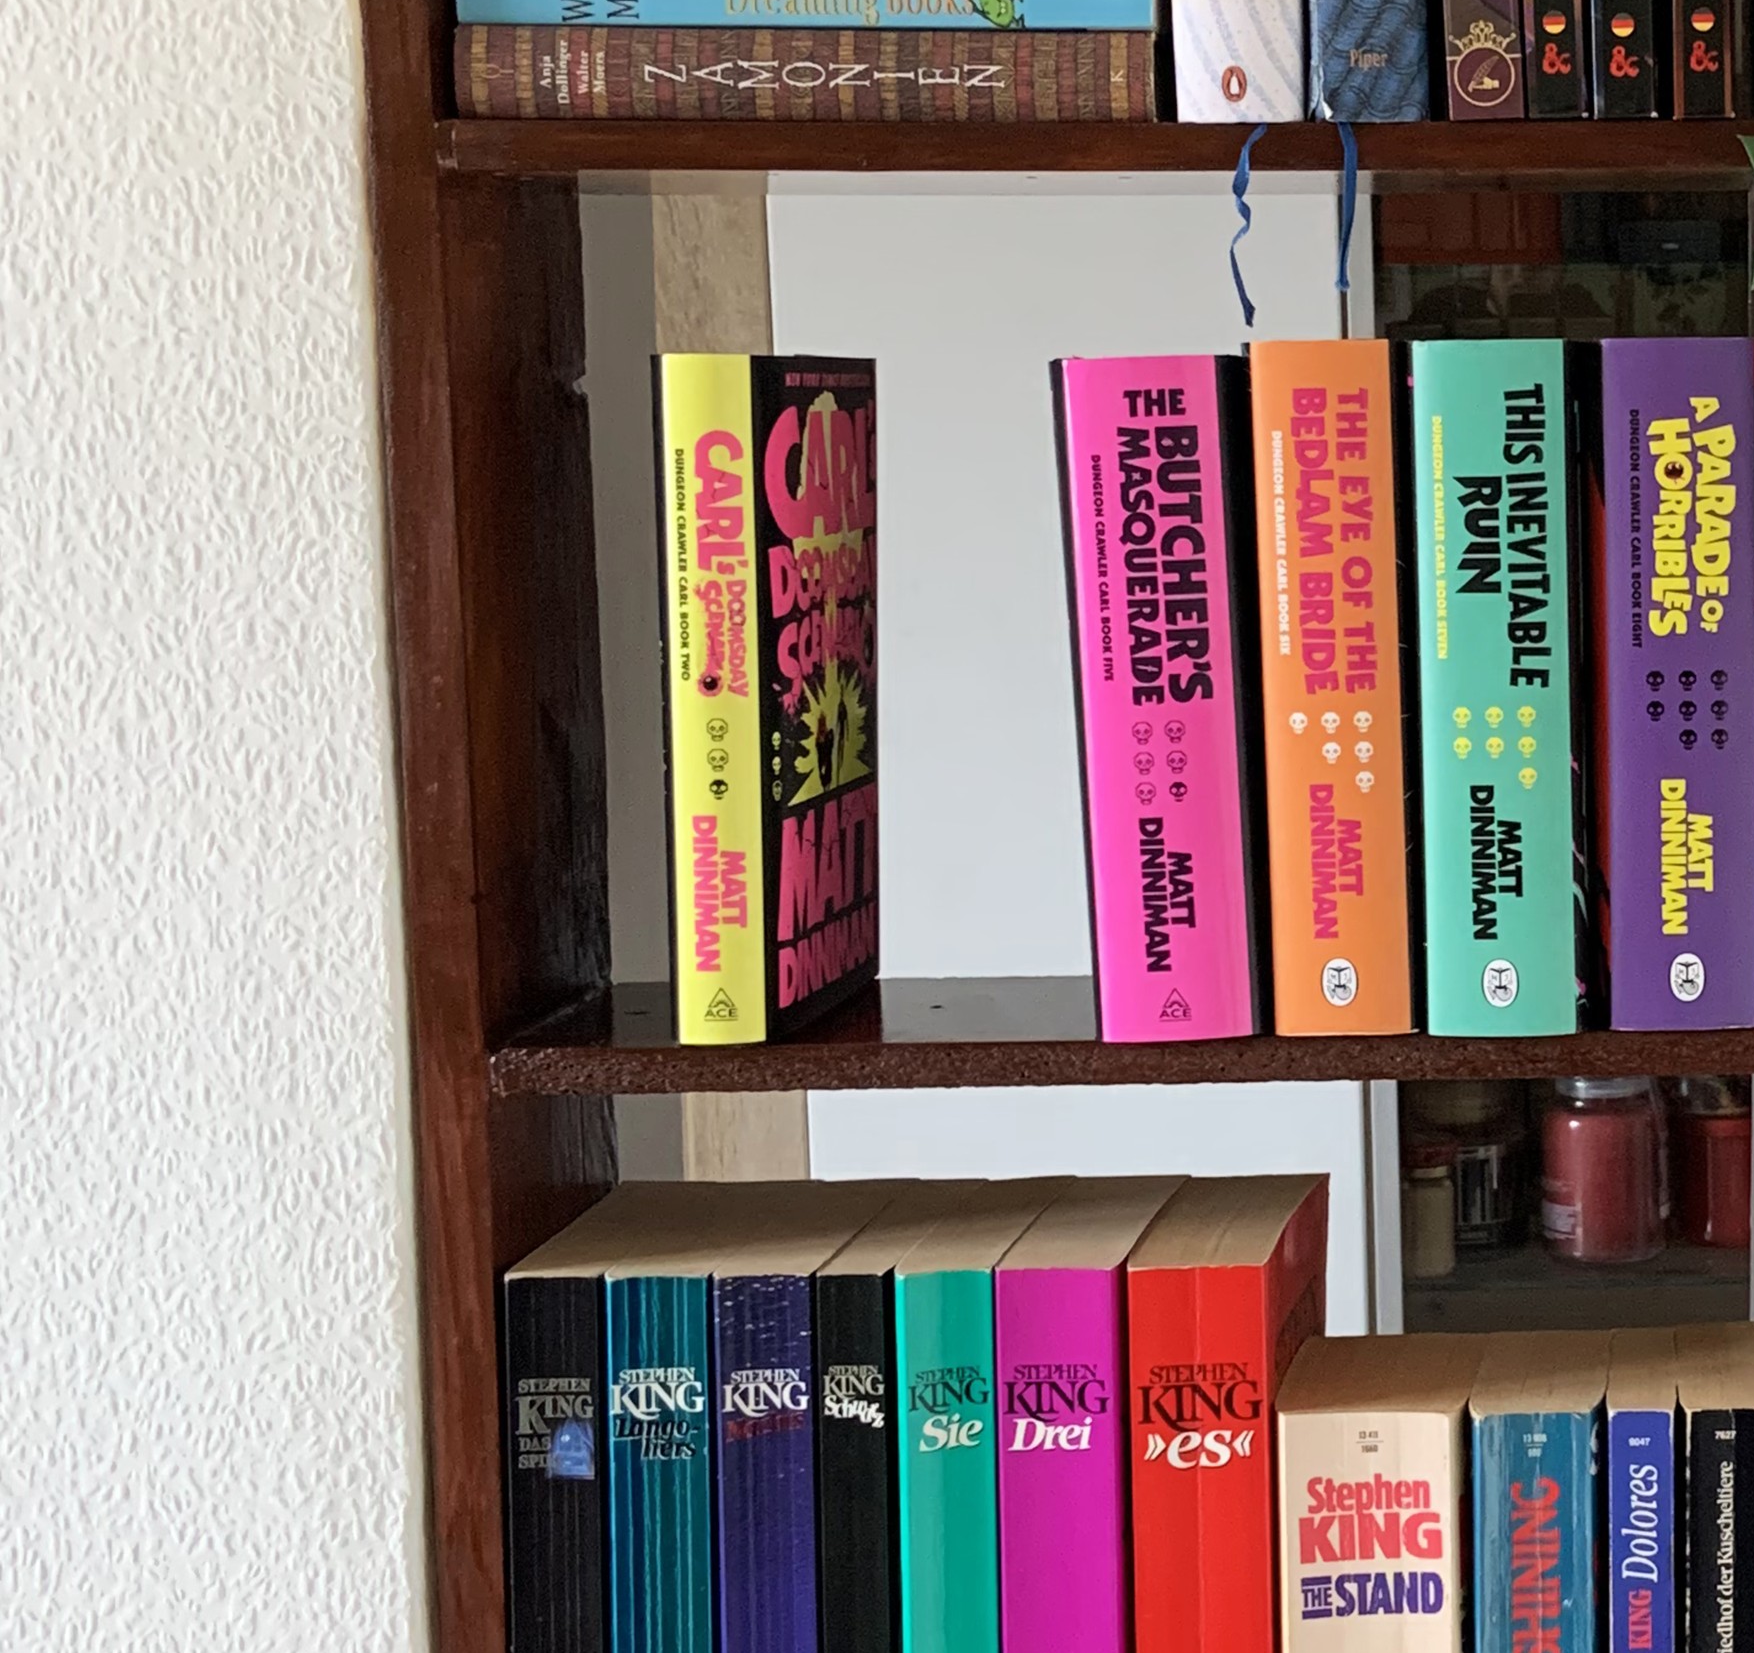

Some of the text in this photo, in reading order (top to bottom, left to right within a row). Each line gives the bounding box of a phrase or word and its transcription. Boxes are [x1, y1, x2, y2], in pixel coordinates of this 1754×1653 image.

[644, 60, 1005, 89] ZAMONIEN
[1123, 388, 1186, 417] THE
[1291, 387, 1339, 696] BEDLAM BRIDE
[1336, 388, 1377, 695] THE EYE OF THE
[1646, 418, 1692, 637] HORRIBLES
[1689, 396, 1736, 634] A PARADE OF
[1117, 426, 1165, 706] MASQUERADE
[1153, 424, 1214, 703] BUTCHER'S
[692, 815, 721, 972] DINNIMAN
[720, 850, 748, 928] MATT
[705, 1007, 738, 1019] ACE
[919, 1415, 984, 1452] Sie
[1008, 1417, 1092, 1452] Drei
[1307, 1473, 1431, 1513] Stephen
[1622, 1464, 1659, 1583] Dolores
[1716, 1461, 1734, 1566] Kuscheltiere
[1298, 1513, 1443, 1564] KING
[1302, 1571, 1444, 1617] THE STAND
[1717, 1567, 1735, 1595] der
